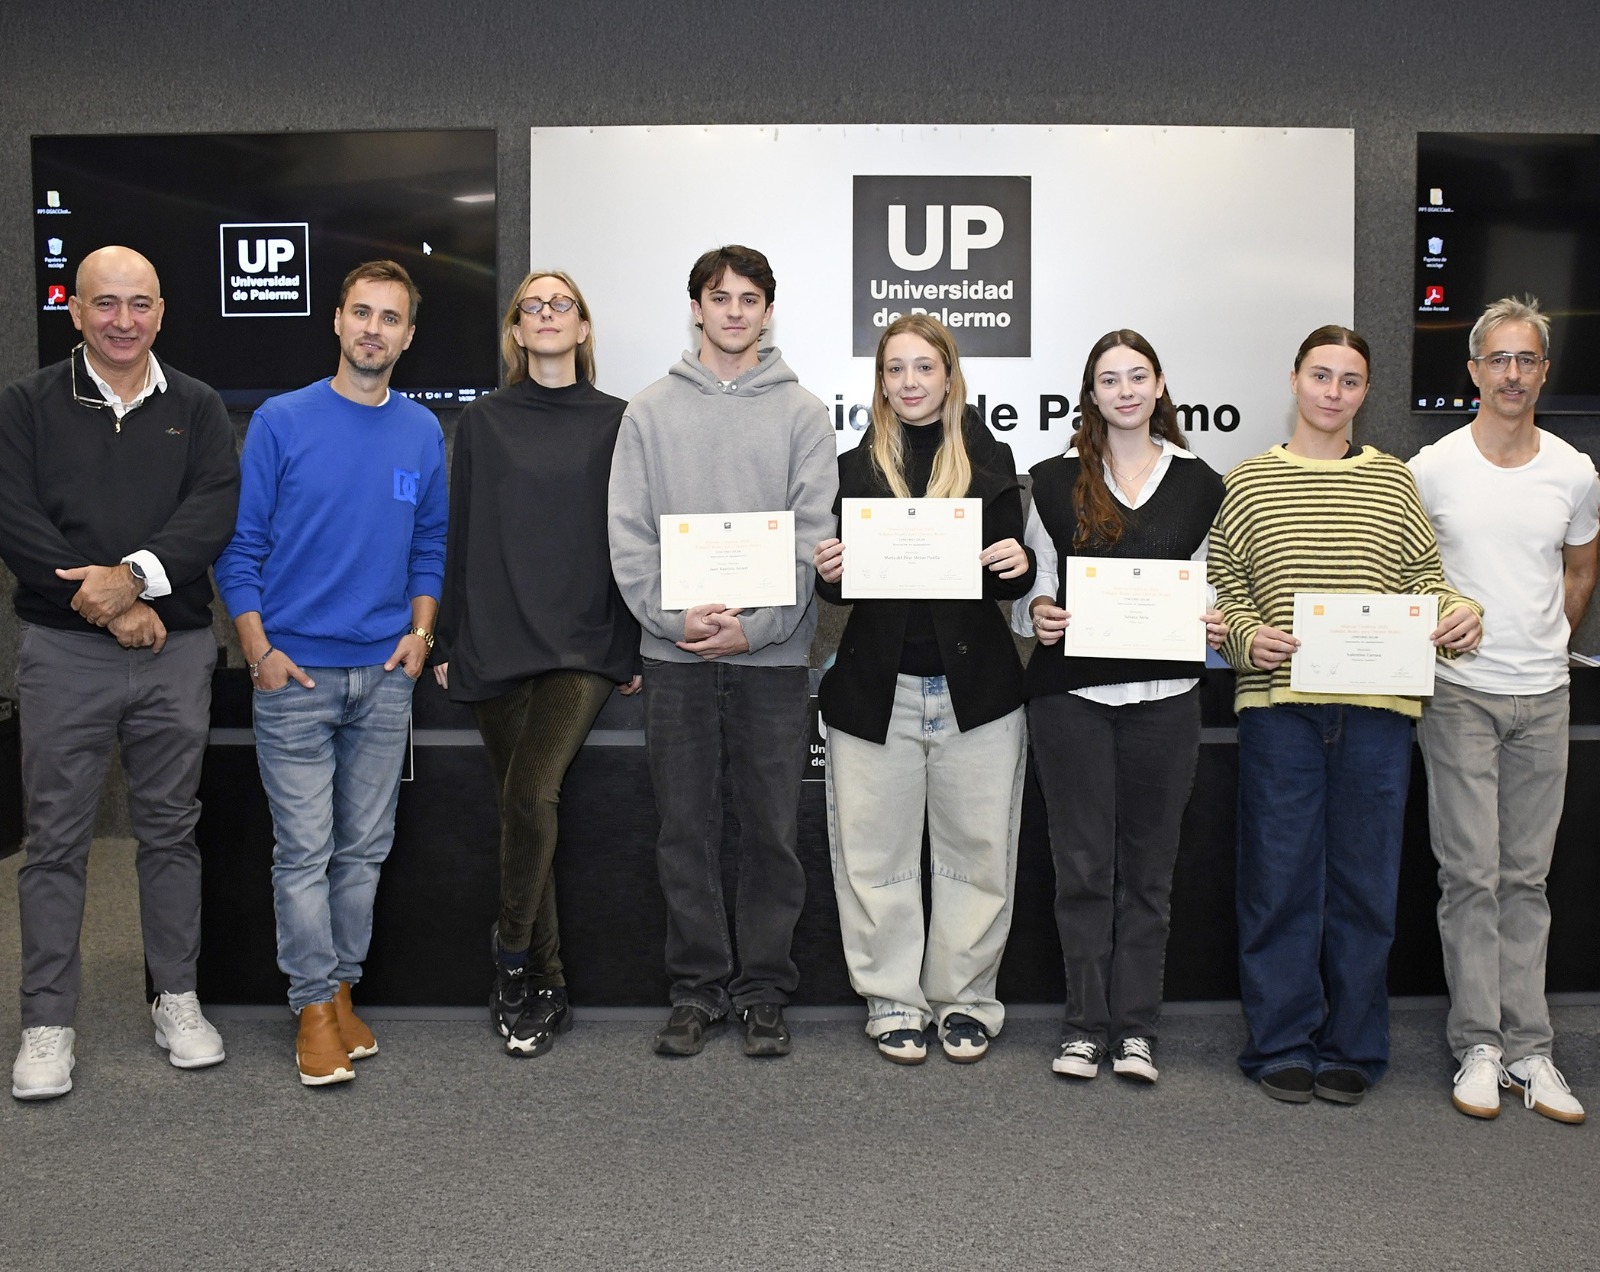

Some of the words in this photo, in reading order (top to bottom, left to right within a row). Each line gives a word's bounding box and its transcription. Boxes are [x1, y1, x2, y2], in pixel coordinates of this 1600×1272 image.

[888, 204, 1005, 272] UP
[237, 238, 295, 274] UP
[230, 275, 300, 288] Universidad
[869, 279, 1014, 301] Universidad
[232, 289, 249, 301] de
[250, 288, 299, 301] Palermo
